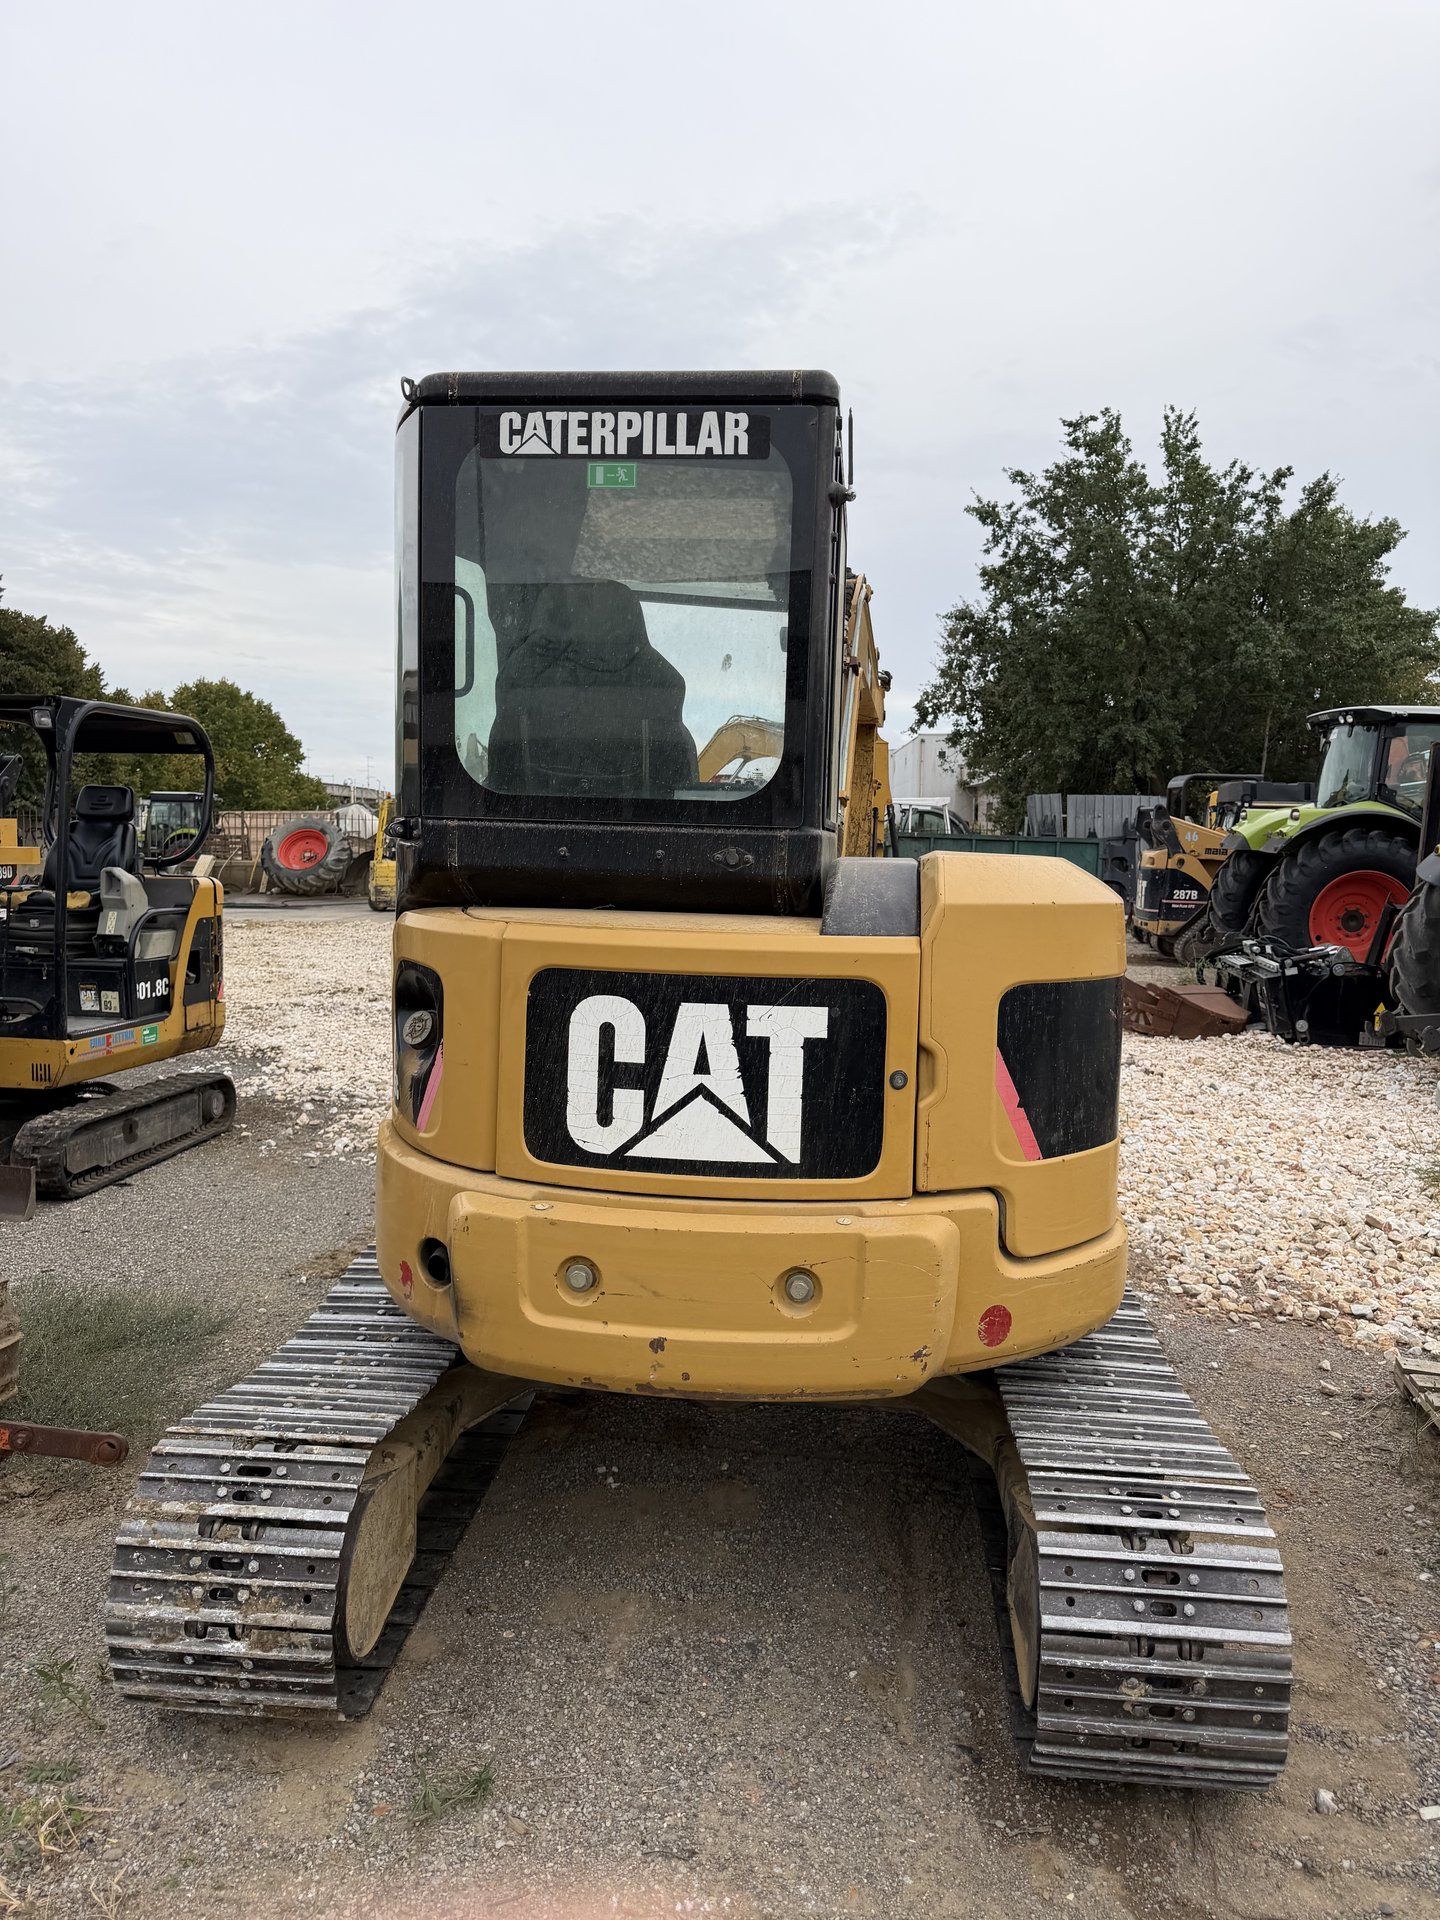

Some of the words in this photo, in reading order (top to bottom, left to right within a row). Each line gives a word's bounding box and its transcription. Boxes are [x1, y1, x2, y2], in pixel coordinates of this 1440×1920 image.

[499, 411, 749, 455] CATERPILLAR
[1185, 831, 1199, 842] 46
[1173, 889, 1199, 900] 287B
[566, 994, 829, 1164] CAT
